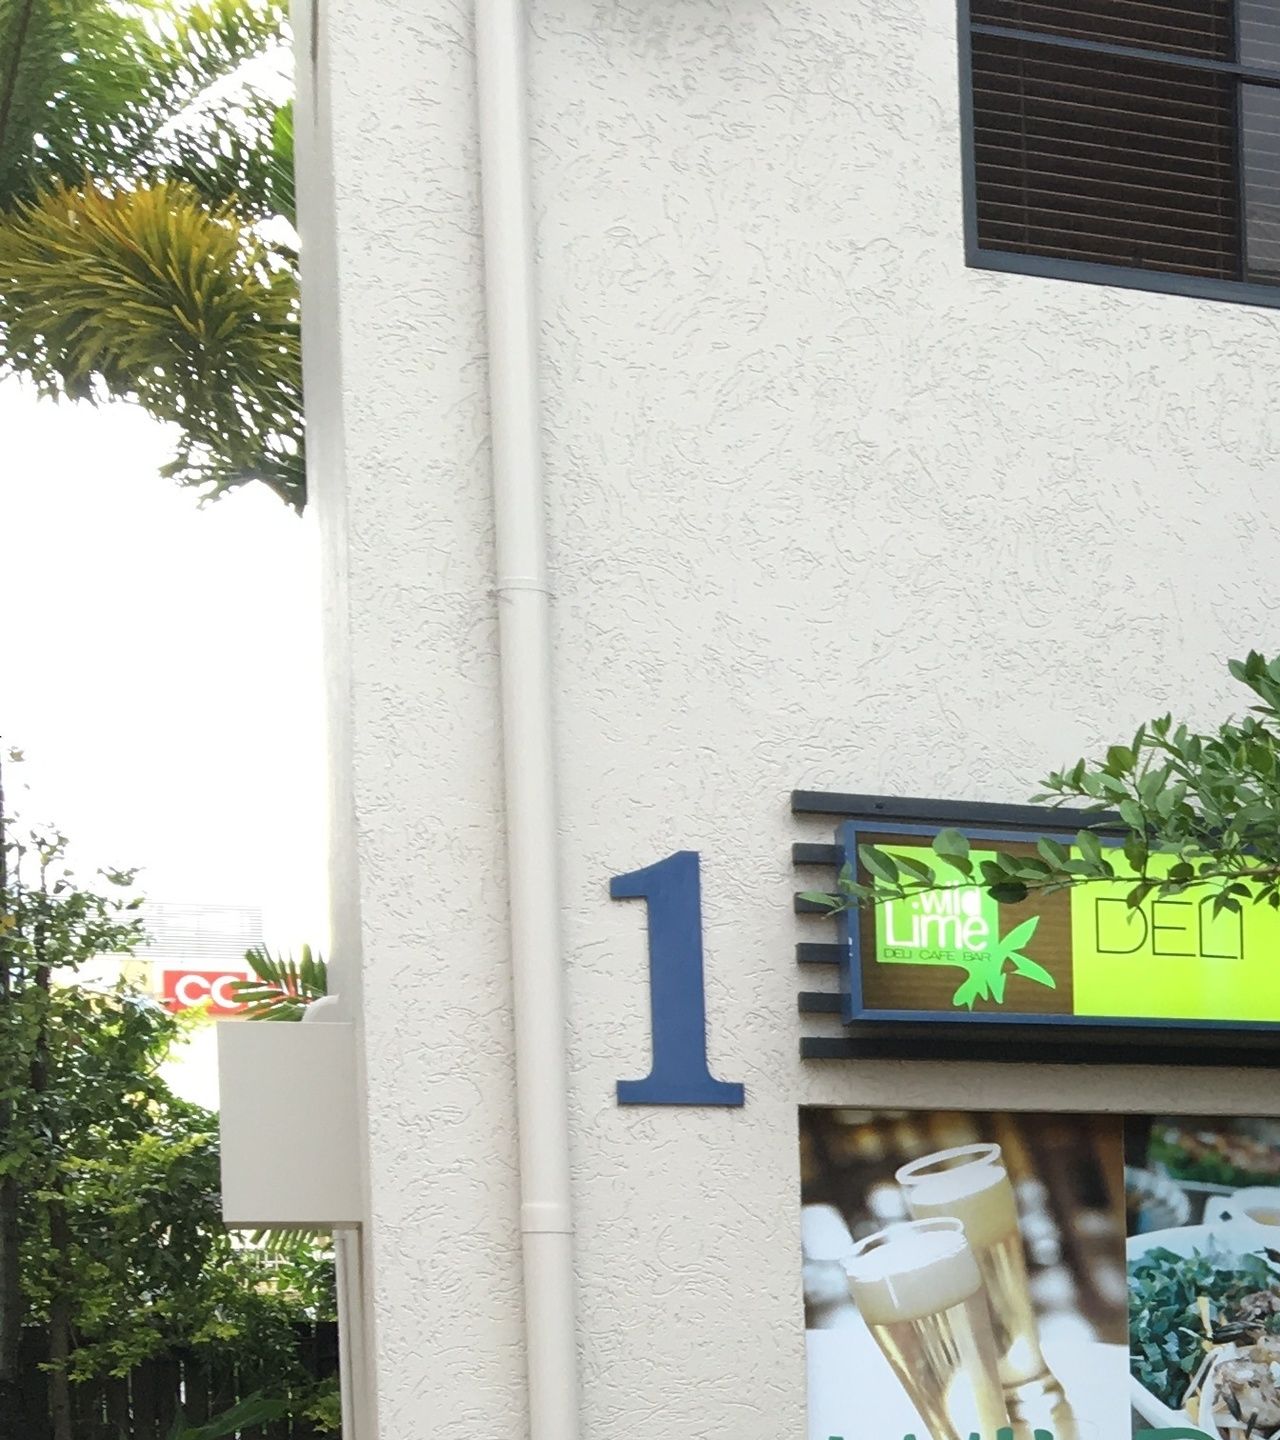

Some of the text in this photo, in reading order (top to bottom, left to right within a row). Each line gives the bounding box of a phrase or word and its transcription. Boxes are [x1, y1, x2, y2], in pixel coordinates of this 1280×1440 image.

[885, 901, 989, 950] Lime
[1096, 897, 1245, 960] DELI
[610, 850, 745, 1106] 1
[884, 948, 991, 962] DELI CAFE BAR
